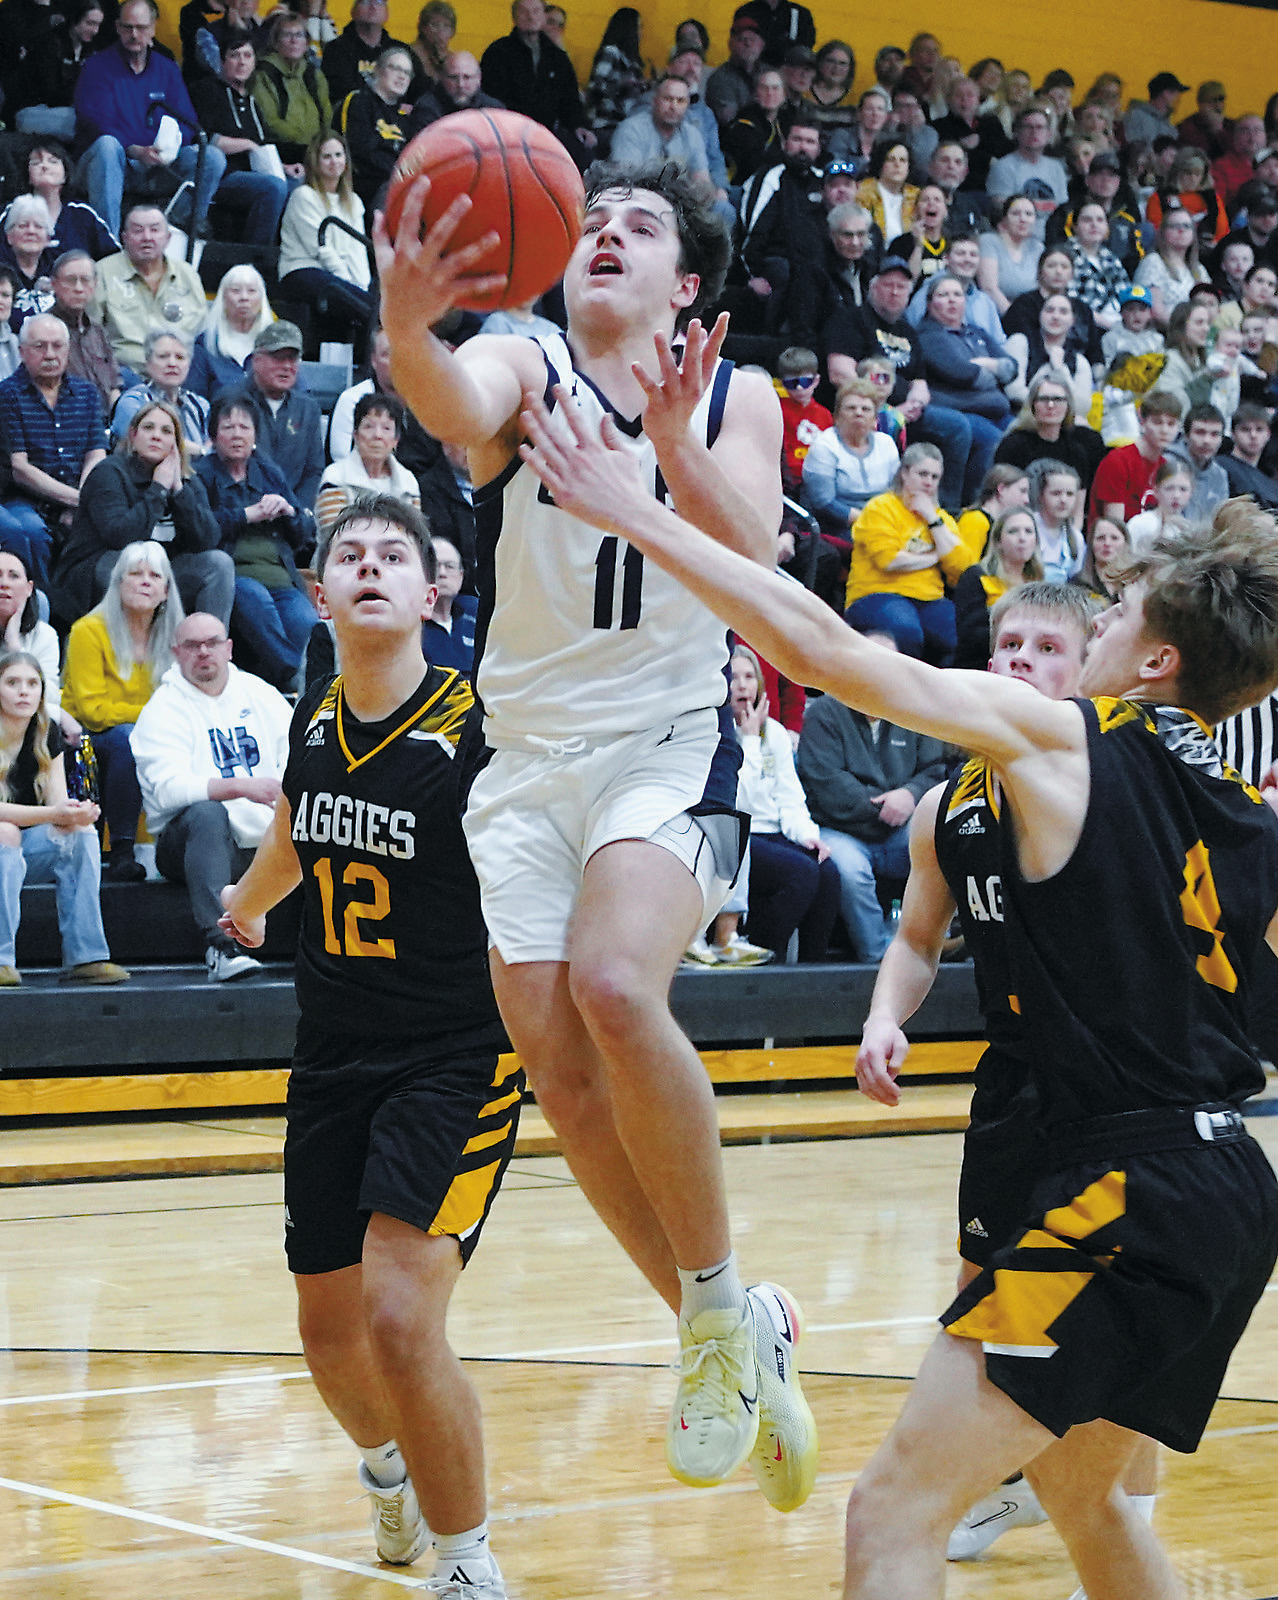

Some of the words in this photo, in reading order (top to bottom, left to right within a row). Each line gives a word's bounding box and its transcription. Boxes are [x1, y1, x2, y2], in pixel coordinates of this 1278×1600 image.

[593, 535, 644, 630] 11
[292, 791, 416, 860] AGGIES
[313, 857, 396, 959] 12
